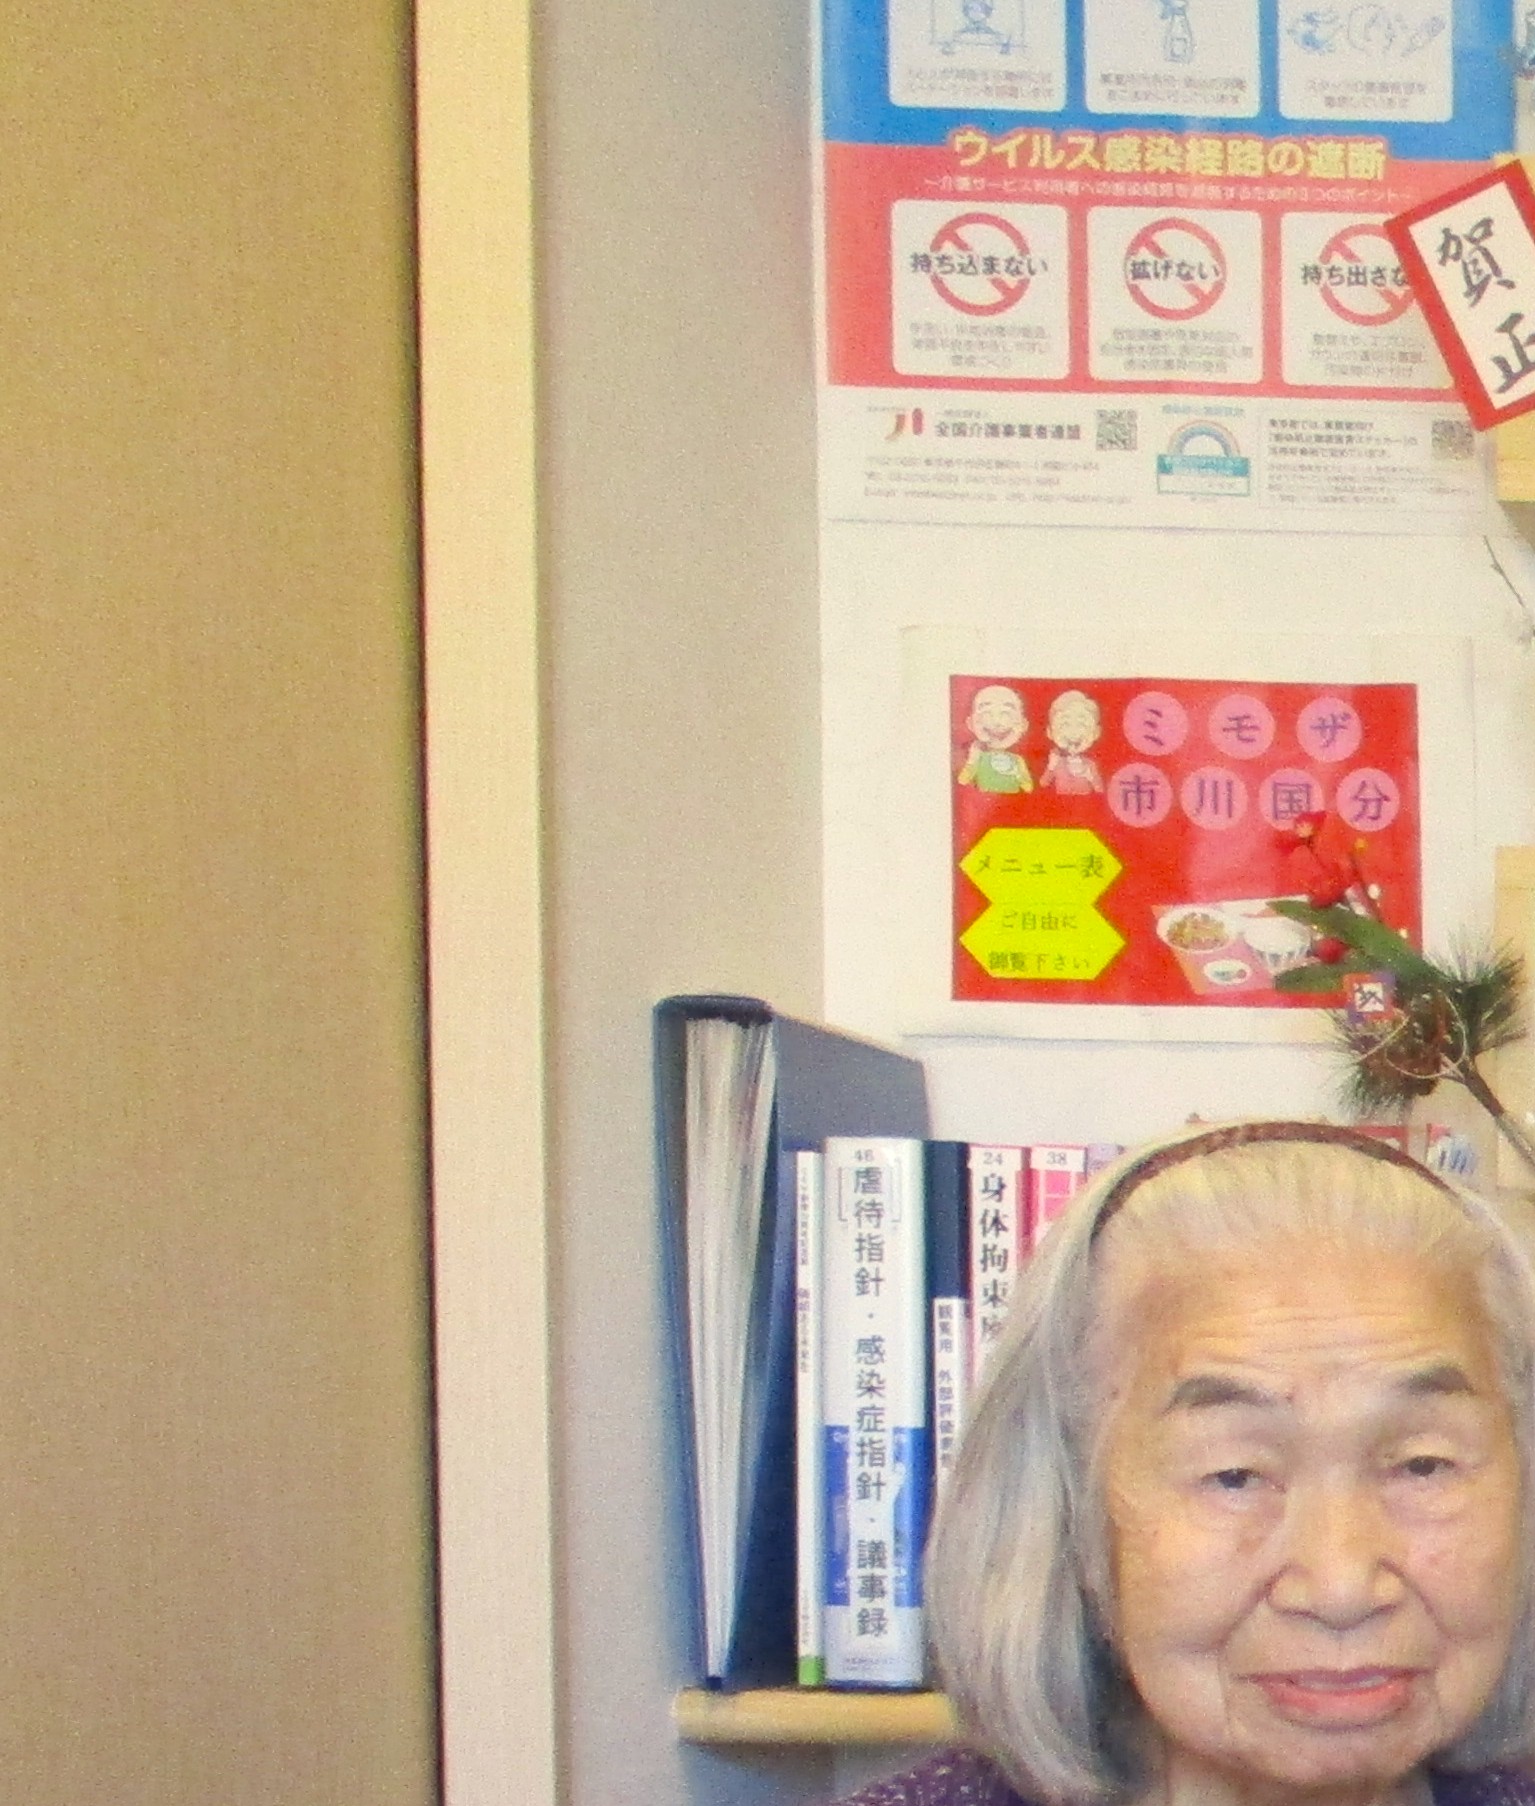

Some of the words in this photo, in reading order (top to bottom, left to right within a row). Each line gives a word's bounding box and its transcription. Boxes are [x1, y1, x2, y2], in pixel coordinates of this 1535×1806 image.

[953, 130, 1387, 182] ウイルス感染経路の遮断
[909, 252, 1048, 277] 持ち込まない
[1129, 259, 1220, 281] 拡げない
[1142, 707, 1352, 748] ミモザ
[1118, 774, 1392, 823] 市川国分
[975, 854, 1104, 879] メニュー表
[1001, 911, 1079, 931] ご自由に
[988, 951, 1090, 973] 御覧下さい
